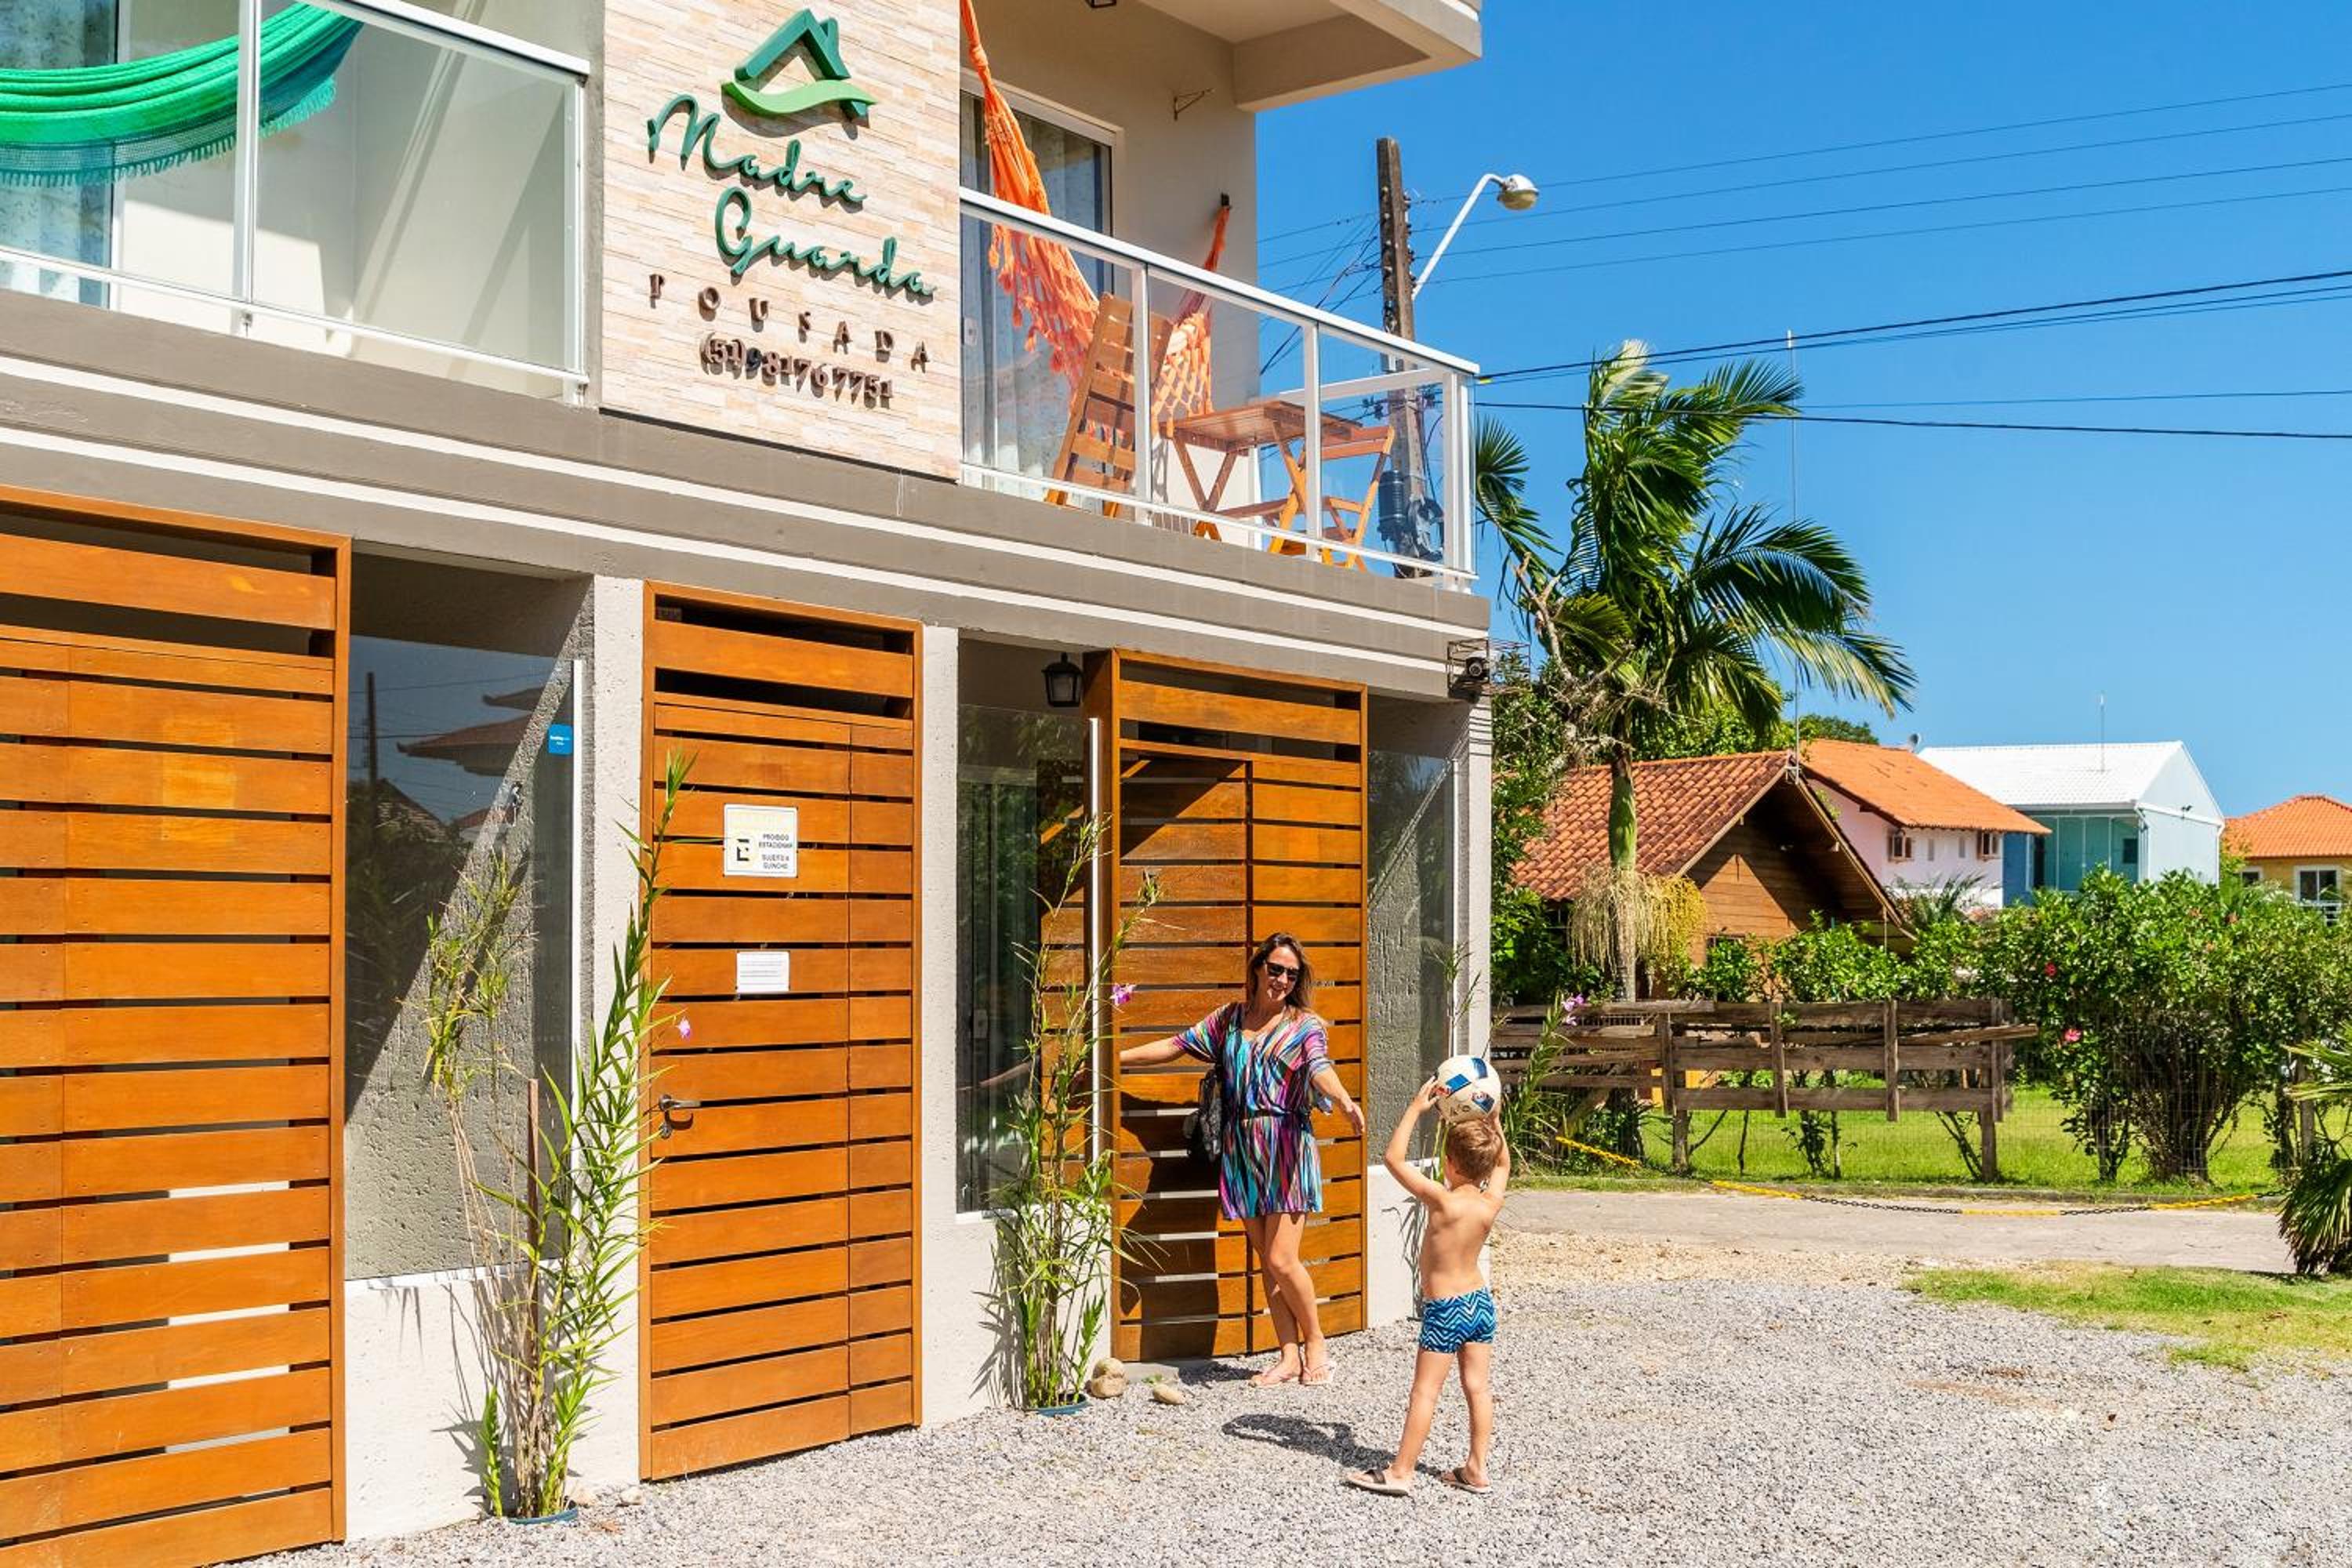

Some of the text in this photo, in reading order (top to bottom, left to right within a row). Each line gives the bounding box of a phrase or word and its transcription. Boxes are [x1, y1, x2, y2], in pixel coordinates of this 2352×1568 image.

[648, 93, 867, 203] Madre
[715, 186, 938, 296] Guarda
[650, 274, 930, 365] POUSADA
